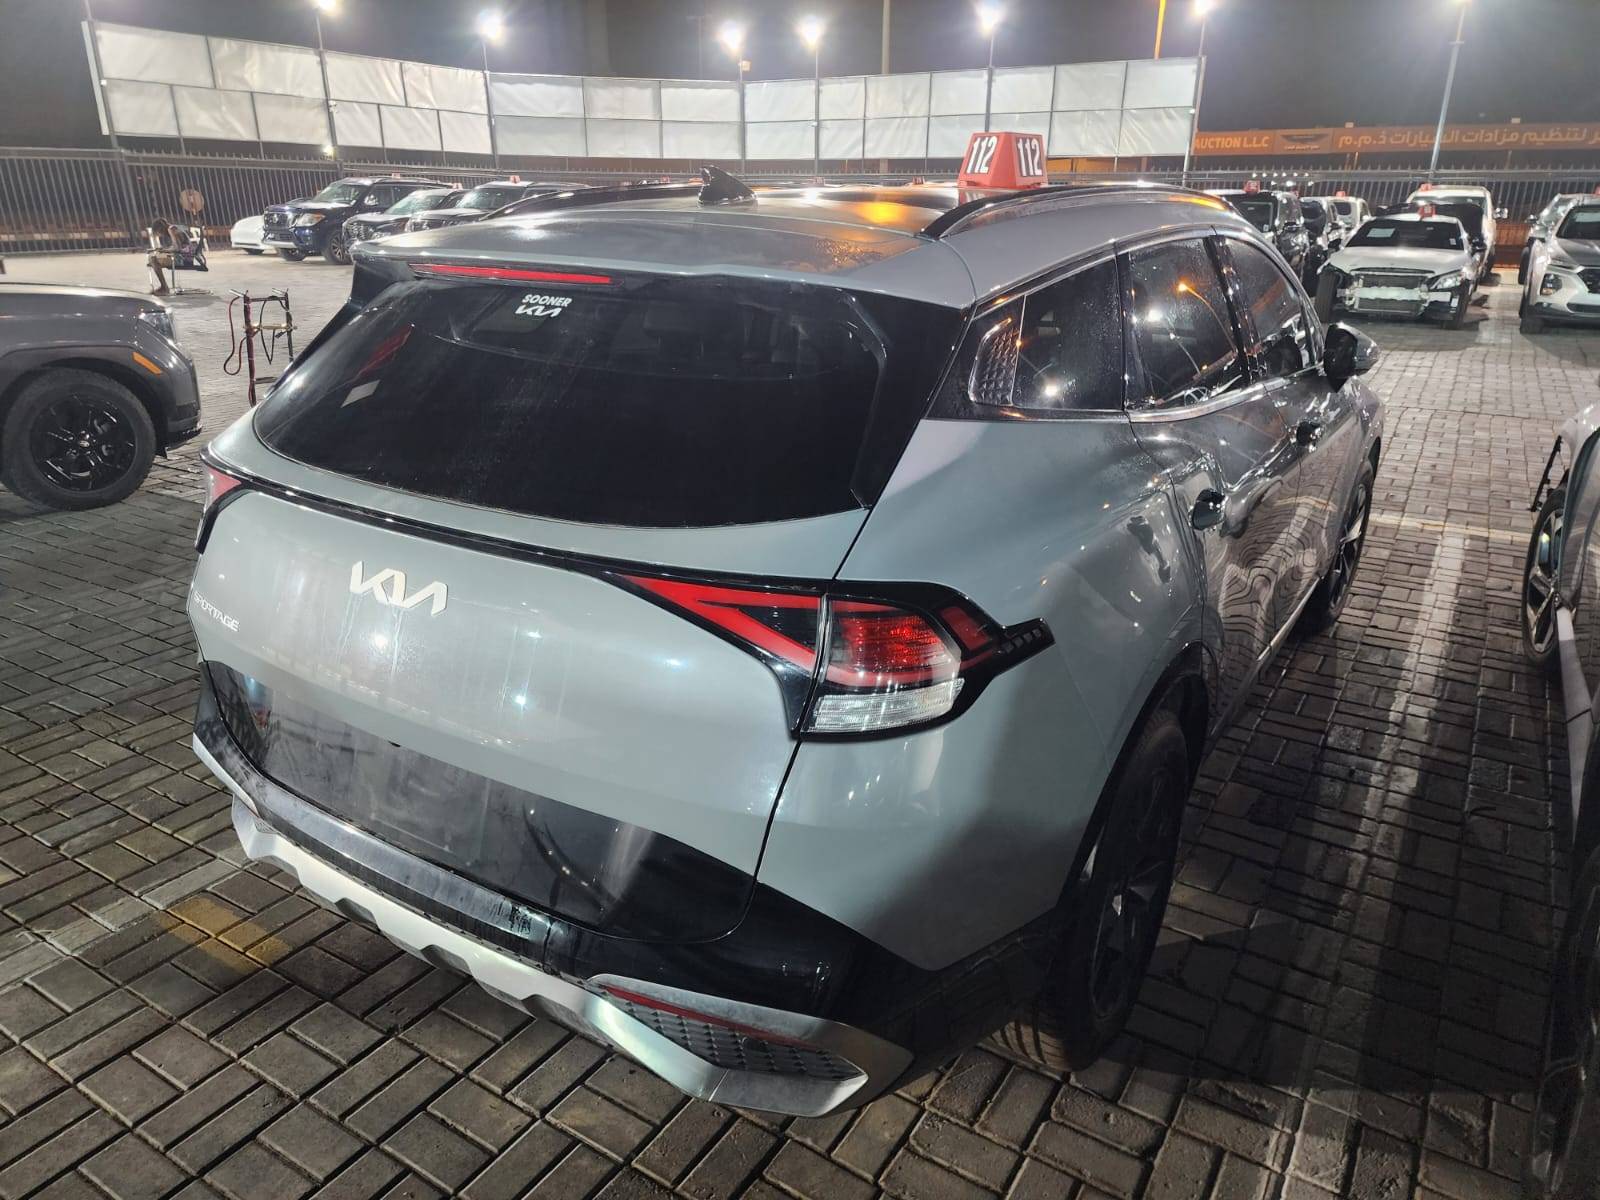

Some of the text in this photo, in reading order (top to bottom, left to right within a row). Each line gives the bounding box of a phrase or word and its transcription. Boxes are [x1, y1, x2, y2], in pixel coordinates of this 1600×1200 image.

[1462, 128, 1519, 146] مزادات
[1521, 127, 1587, 146] لتنظيم
[966, 135, 998, 174] 112
[1017, 137, 1043, 177] 112
[515, 304, 562, 318] KIA
[522, 293, 573, 308] SOONER
[349, 560, 448, 617] KIA
[193, 590, 240, 632] SPORTAGE
